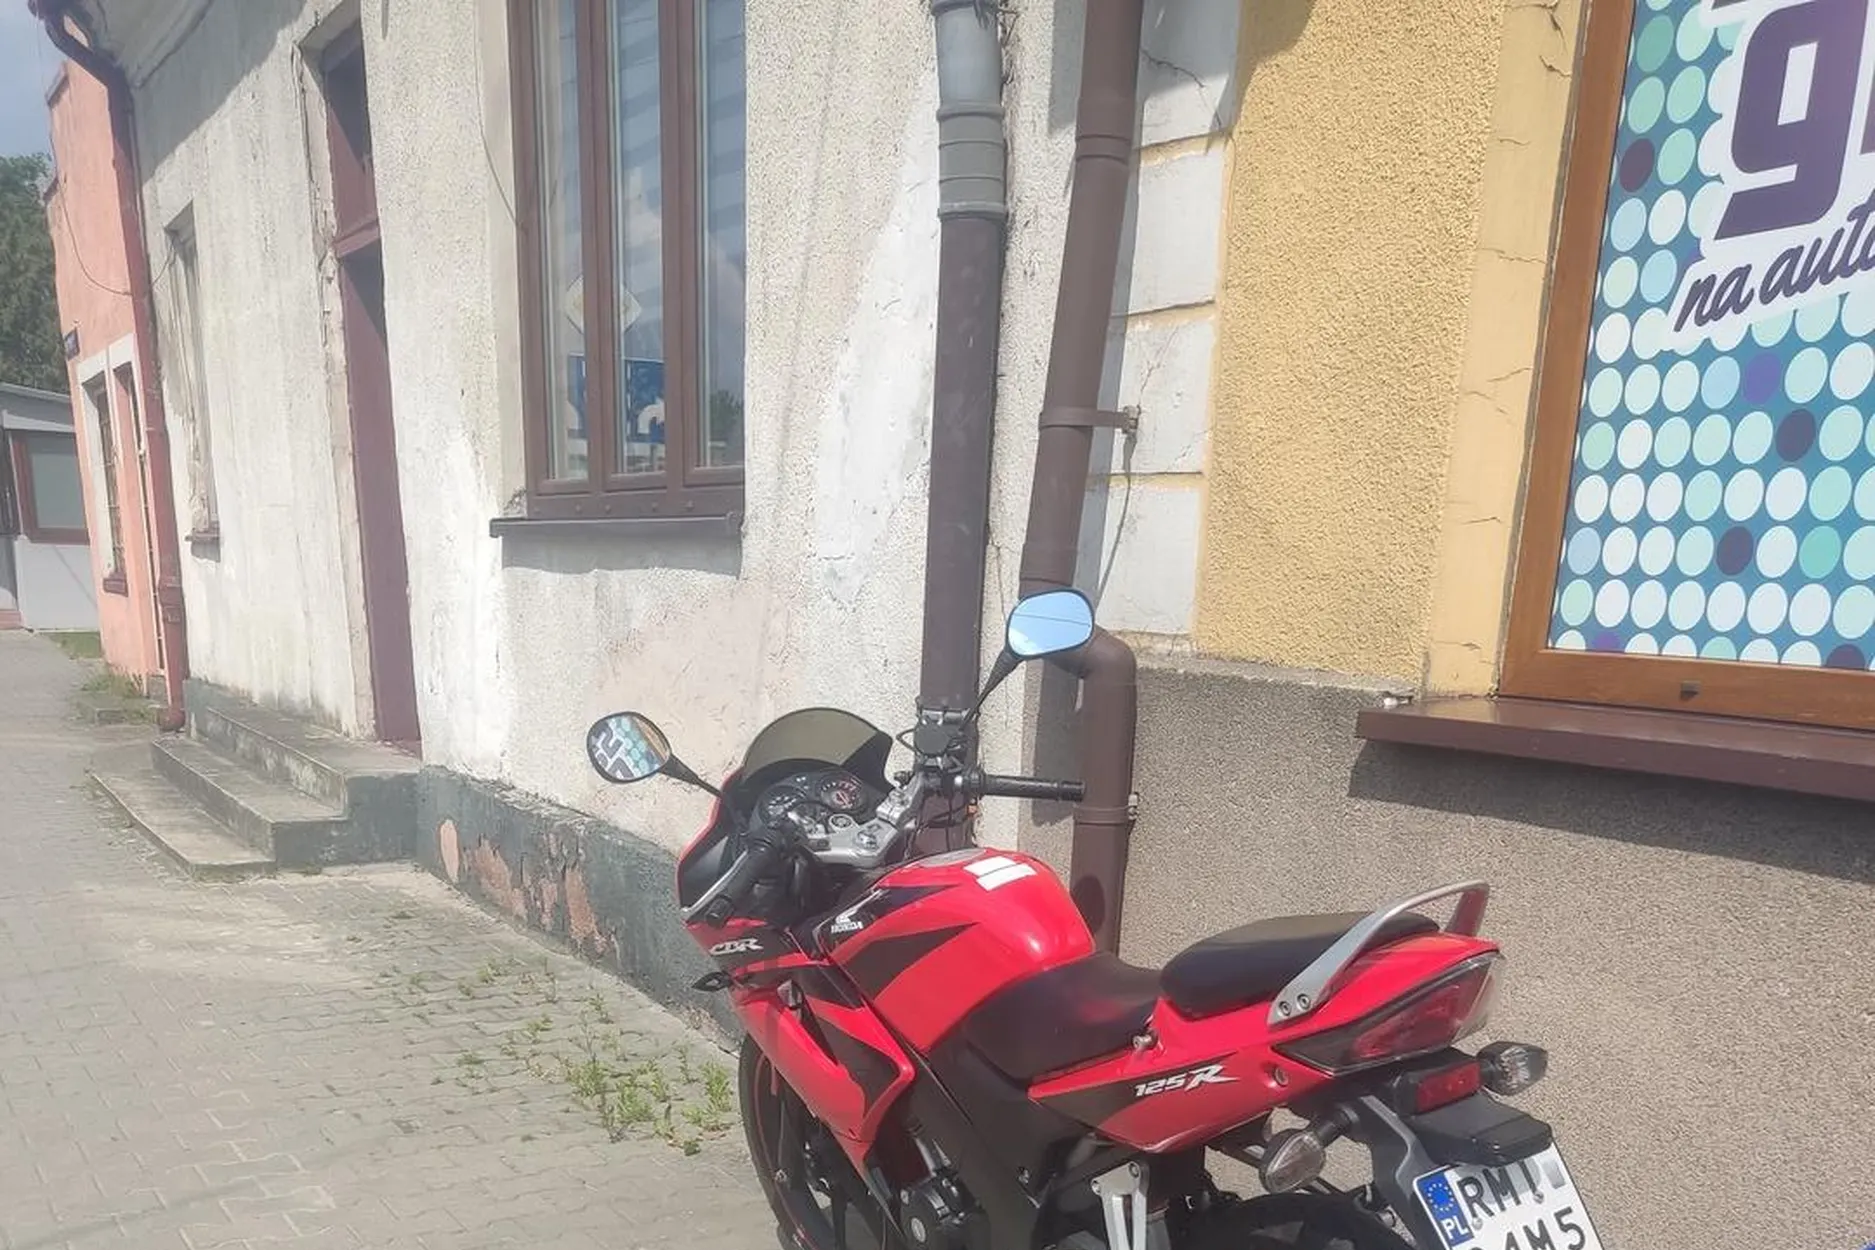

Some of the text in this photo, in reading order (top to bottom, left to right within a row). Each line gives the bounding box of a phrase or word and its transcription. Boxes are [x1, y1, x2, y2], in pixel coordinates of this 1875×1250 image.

[1674, 264, 1754, 332] na
[709, 938, 764, 955] CBR
[1441, 1214, 1469, 1240] PL
